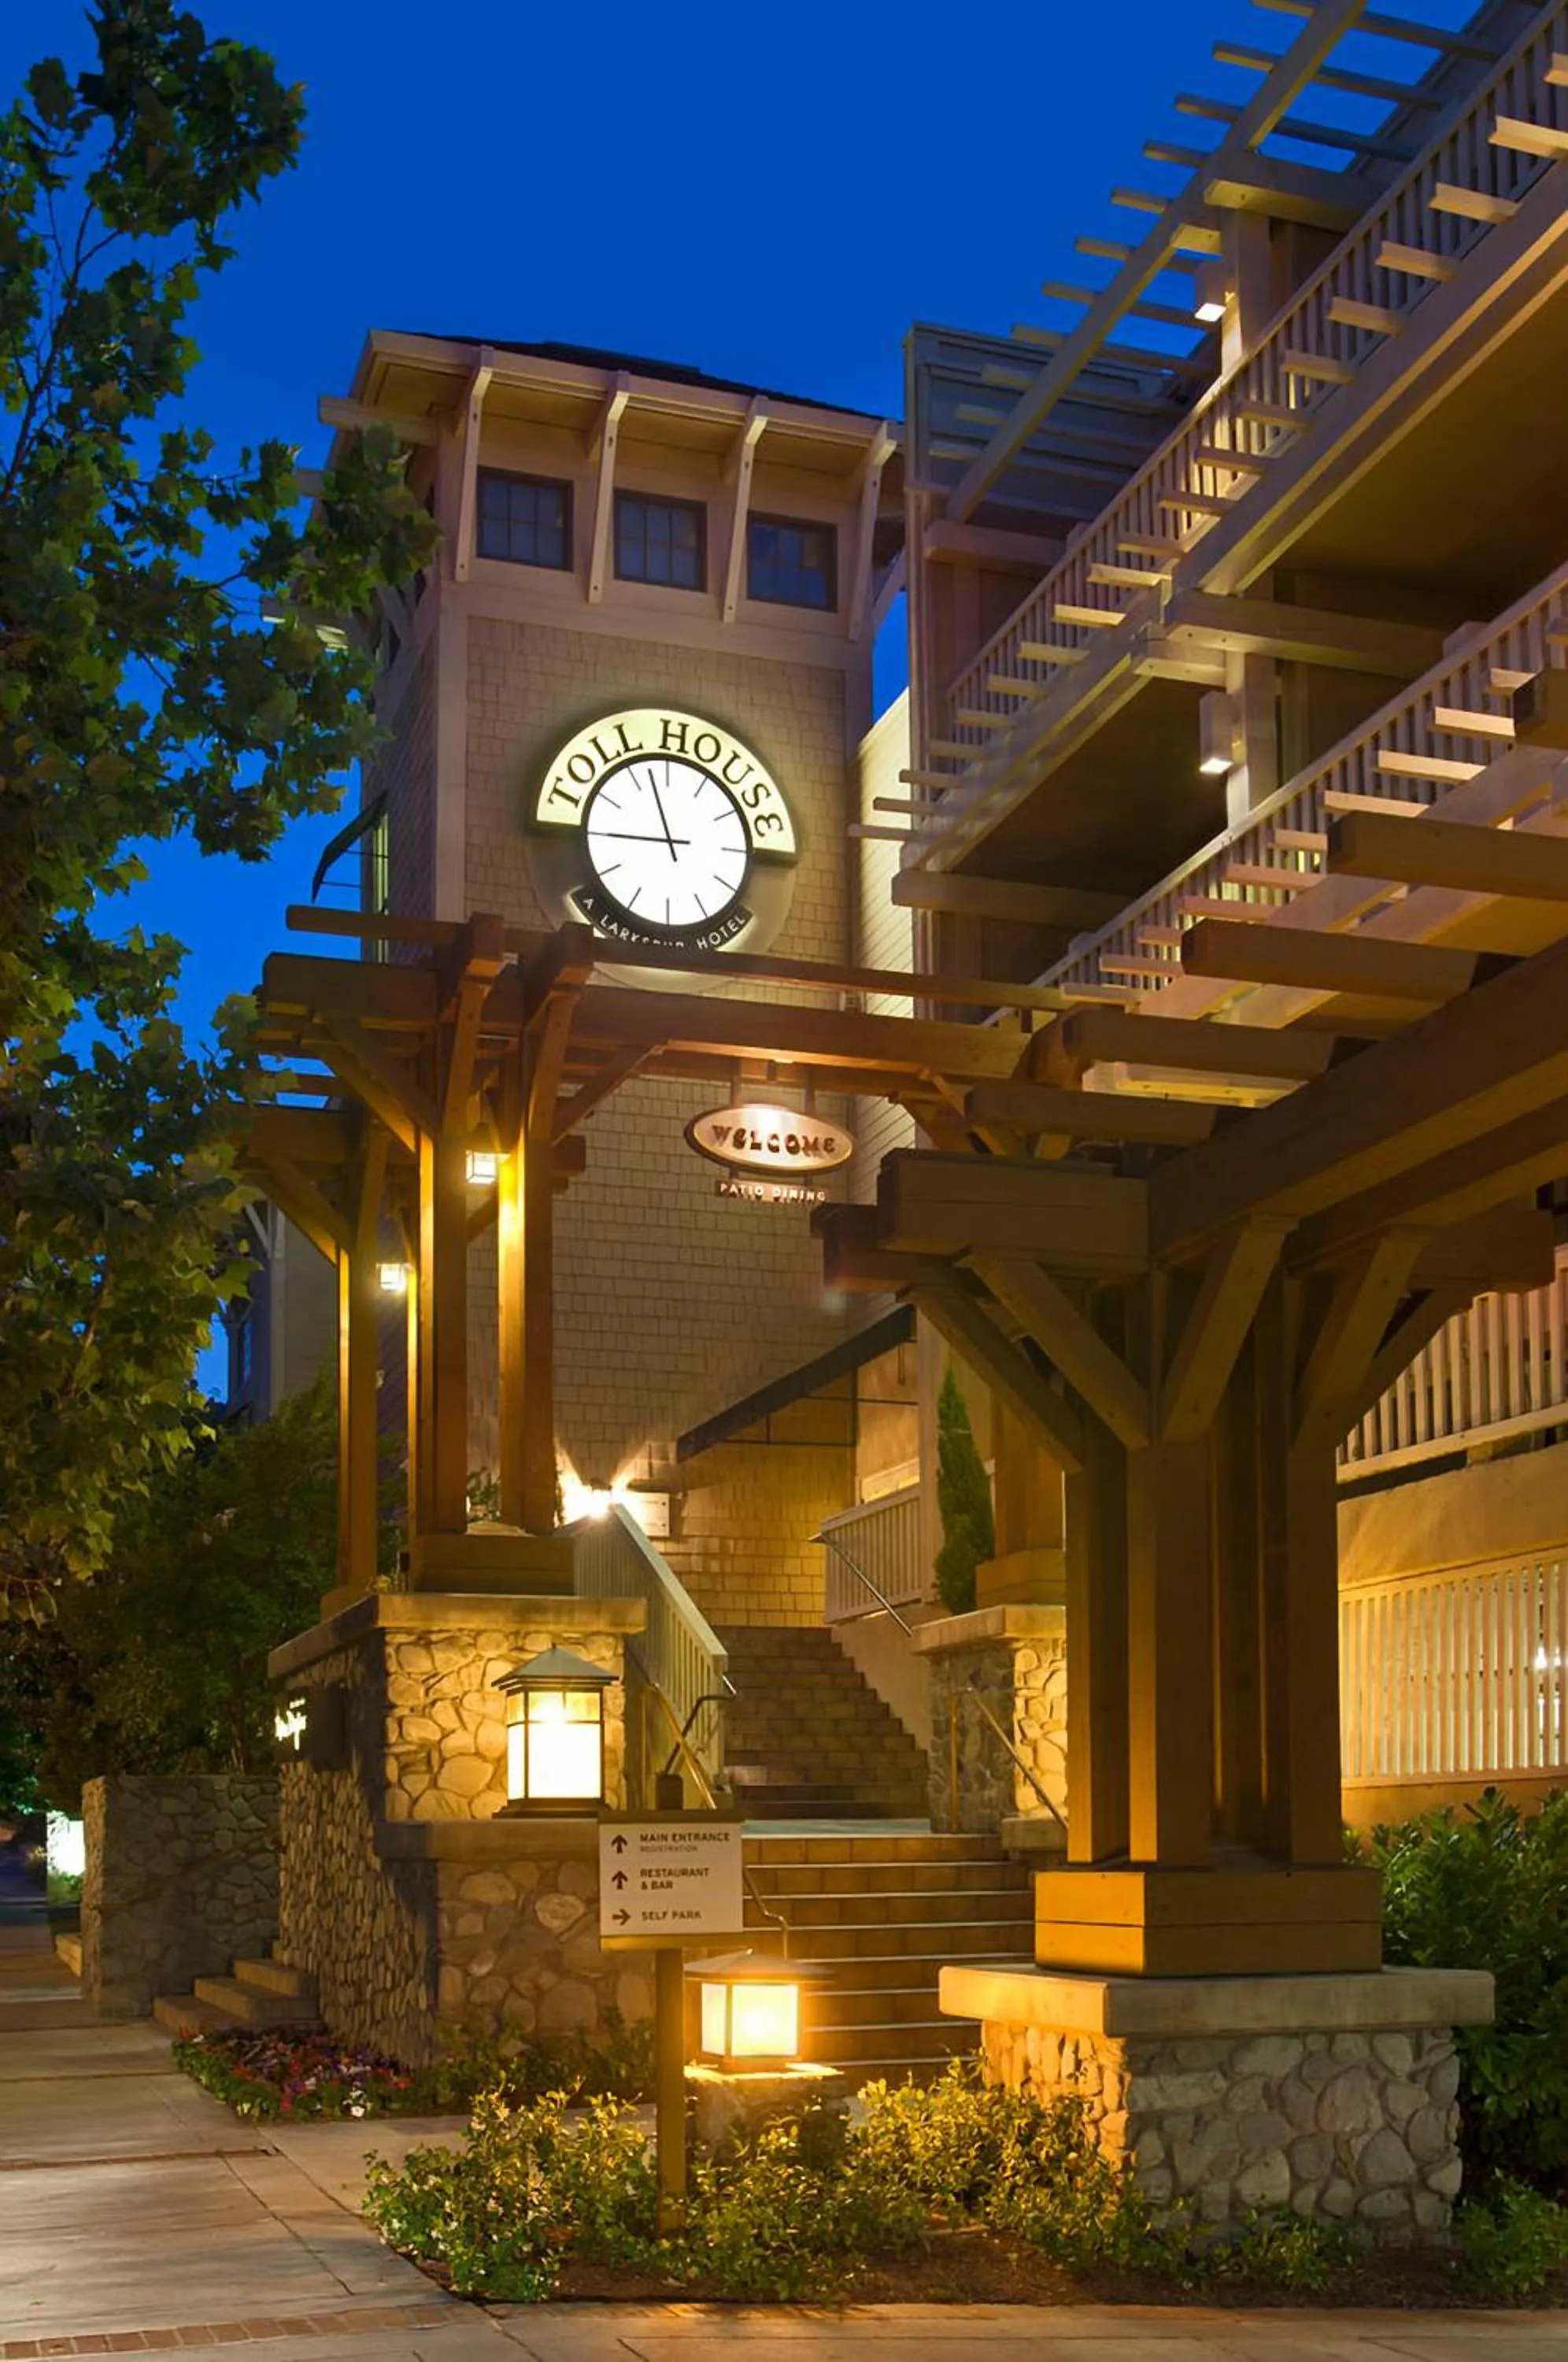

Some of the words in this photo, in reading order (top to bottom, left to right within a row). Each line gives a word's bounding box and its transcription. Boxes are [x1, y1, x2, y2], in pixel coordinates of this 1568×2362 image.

[547, 723, 644, 810] TOLL
[658, 717, 784, 839] HOUSE
[582, 898, 594, 910] A
[696, 913, 746, 950] HOTEL
[712, 1125, 835, 1157] WELCOME
[719, 1183, 764, 1197] PATIO
[771, 1187, 827, 1201] DINING
[640, 1833, 668, 1842] MAIN
[671, 1832, 730, 1842] ENTRANCE
[641, 1868, 709, 1878] RESTAURANT
[641, 1881, 648, 1890] &
[651, 1881, 674, 1890] BAR
[642, 1912, 668, 1921] SELF
[671, 1911, 701, 1920] PARK
